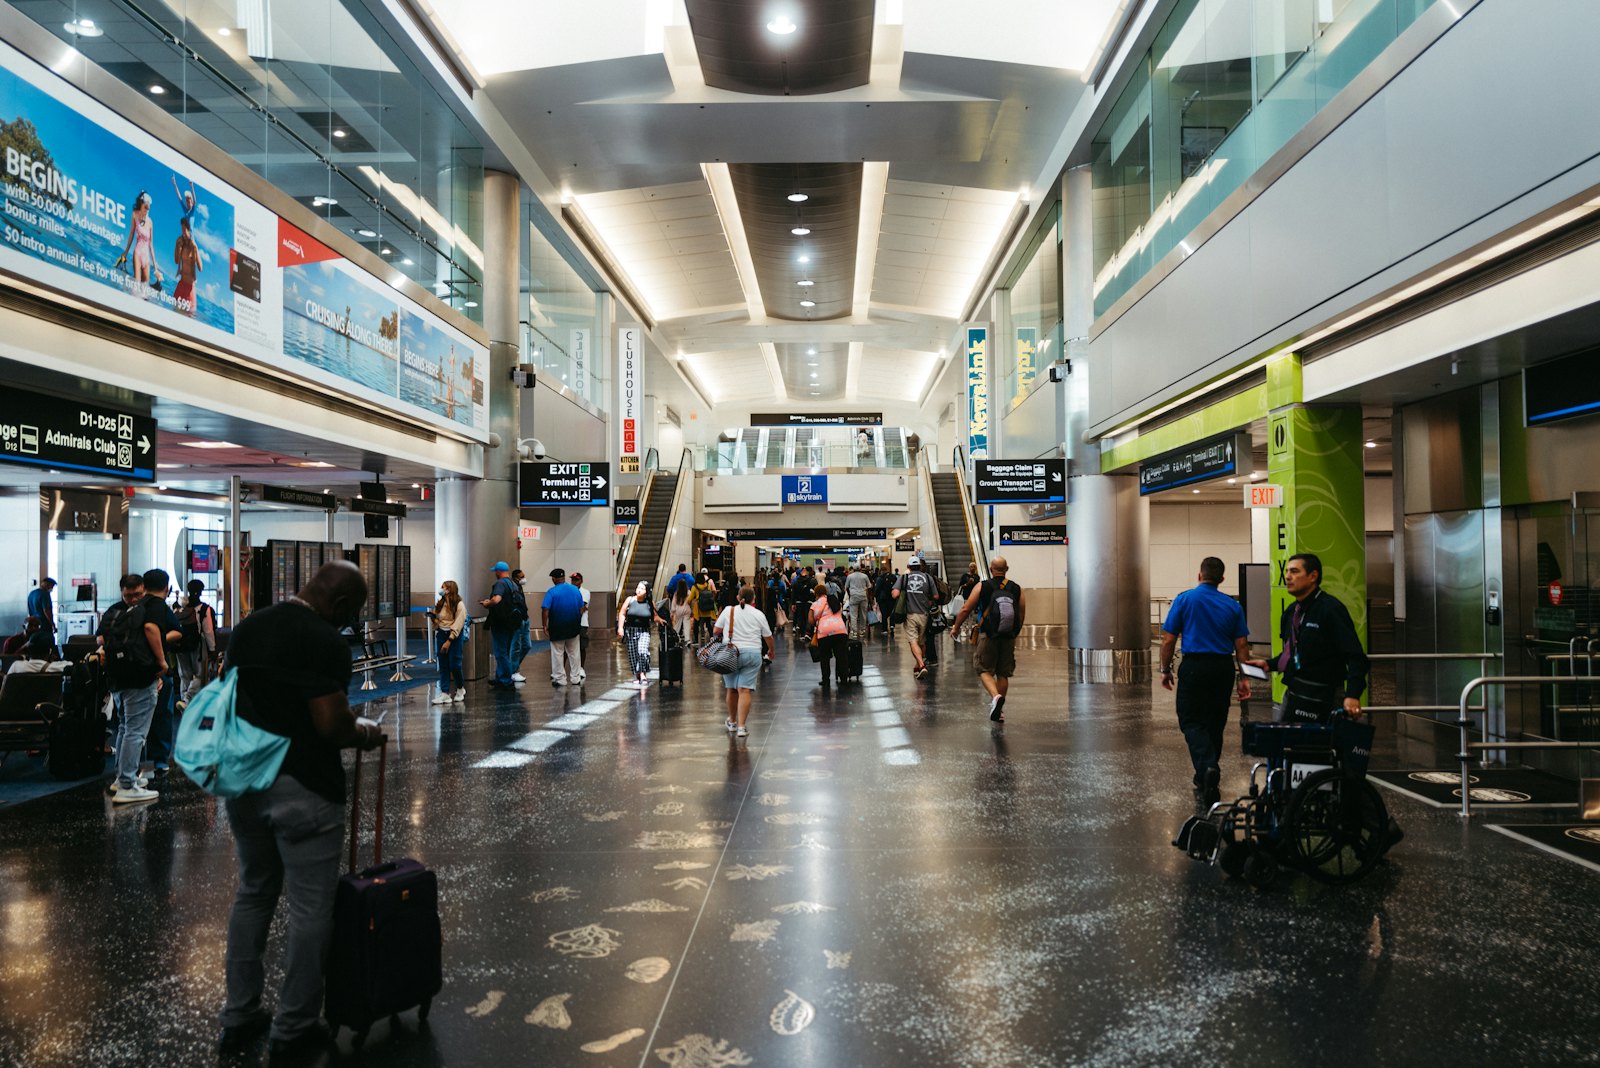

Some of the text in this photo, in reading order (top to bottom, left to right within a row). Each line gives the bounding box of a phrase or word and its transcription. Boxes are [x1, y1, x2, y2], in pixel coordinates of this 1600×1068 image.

[7, 147, 125, 228] BEGINS HERE
[5, 182, 29, 203] with
[31, 192, 65, 219] 50,000
[5, 198, 66, 238] bonus miles.
[5, 225, 19, 244] $0
[20, 231, 45, 253] intro
[47, 243, 78, 267] annual
[80, 256, 95, 275] fee
[96, 263, 109, 279] for
[110, 269, 124, 285] the
[161, 289, 177, 307] then
[306, 300, 345, 335] CRUISING
[346, 320, 371, 346] ALONG
[969, 340, 987, 437] NewsLink
[80, 411, 117, 432] D1-D25
[45, 429, 116, 455] Admirals Club
[625, 422, 634, 451] one
[5, 441, 17, 451] D12
[549, 464, 578, 475] EXIT
[621, 464, 639, 472] & BAR
[986, 465, 1014, 473] Baggage
[541, 478, 578, 486] Terminal
[801, 482, 809, 492] 2
[1003, 480, 1033, 488] Transport
[542, 491, 578, 500] F, G, H, J
[797, 493, 822, 502] skytrain
[1251, 488, 1275, 505] EXIT
[616, 506, 636, 515] D25
[523, 527, 537, 538] EXIT
[1295, 708, 1318, 720] envoy
